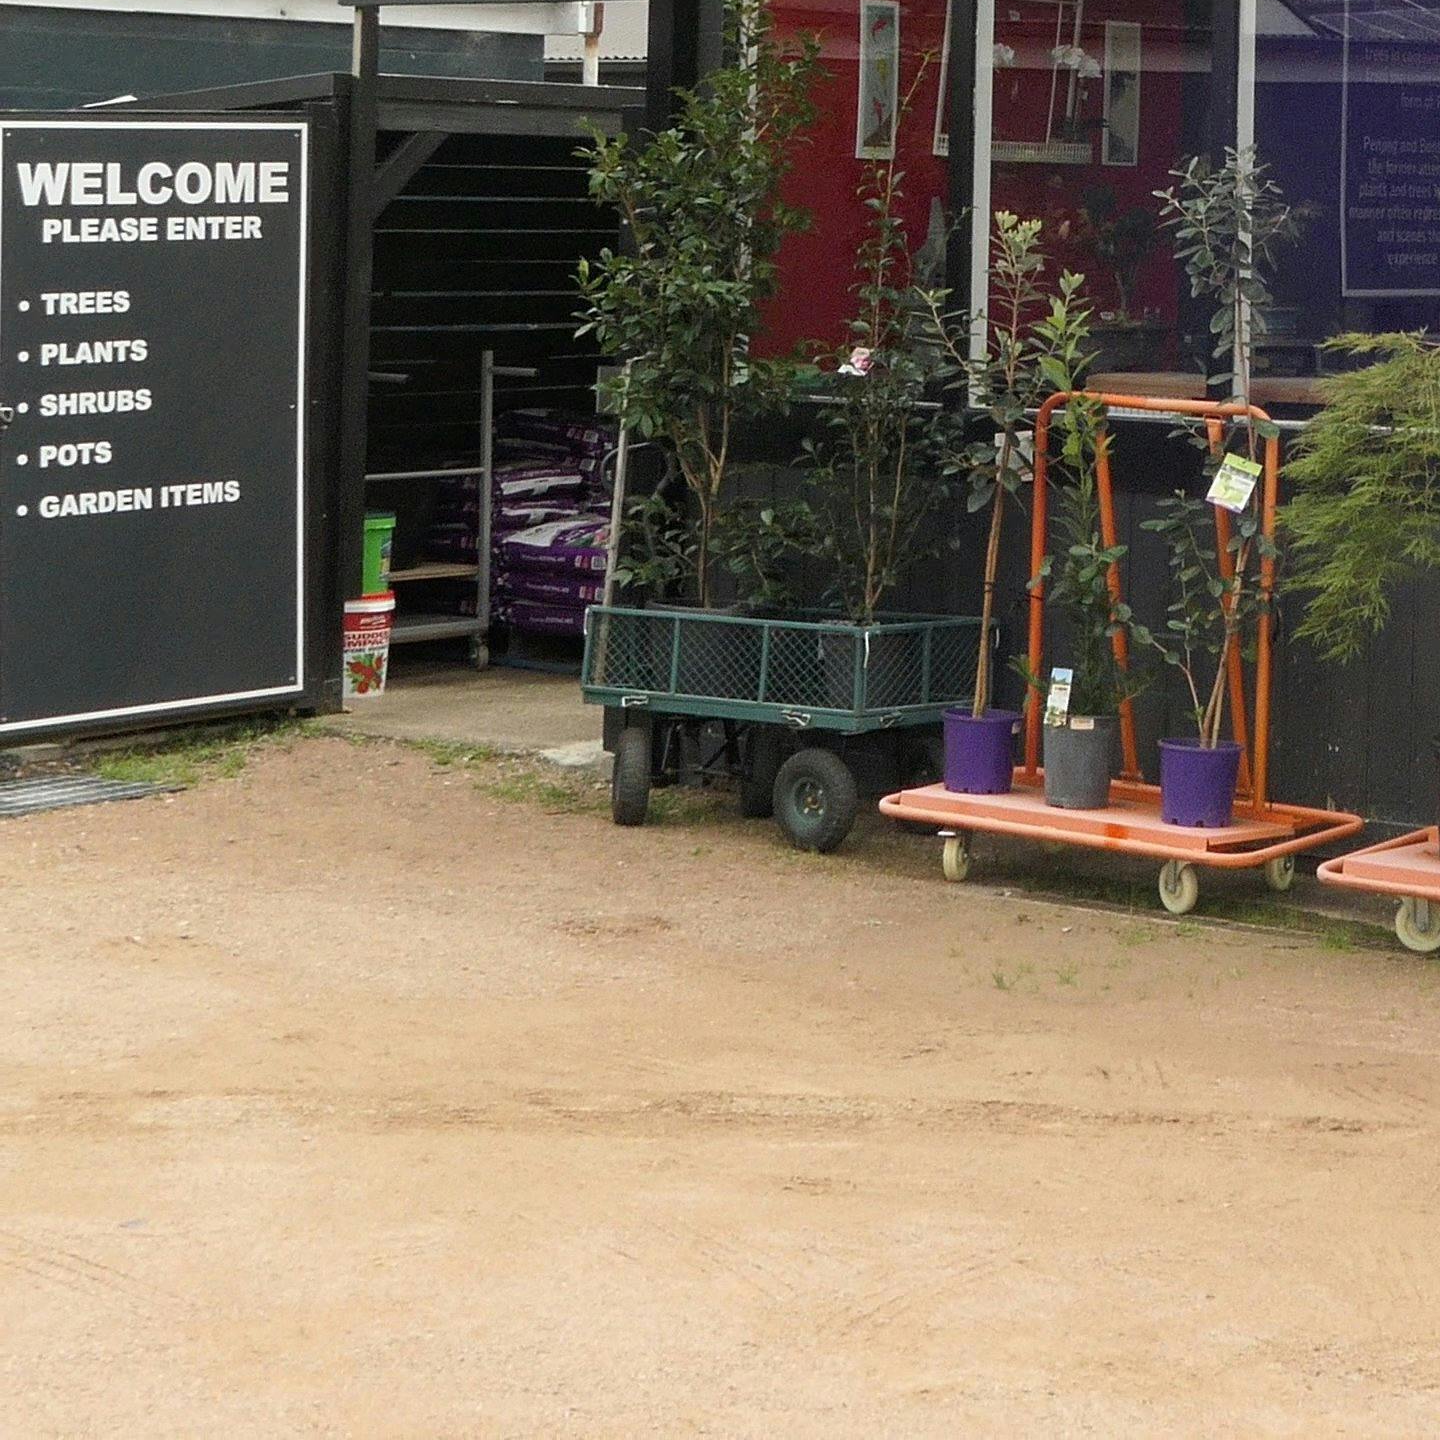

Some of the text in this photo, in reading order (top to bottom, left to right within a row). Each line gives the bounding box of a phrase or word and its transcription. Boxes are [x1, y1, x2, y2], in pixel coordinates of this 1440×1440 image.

[17, 162, 289, 206] WELCOME
[43, 216, 262, 243] PLEASE ENTER
[41, 291, 130, 315] TREES
[41, 340, 147, 366] PLANTS
[40, 389, 152, 416] SHRUBS
[40, 442, 112, 468] POTS
[39, 481, 240, 518] GARDEN ITEMS
